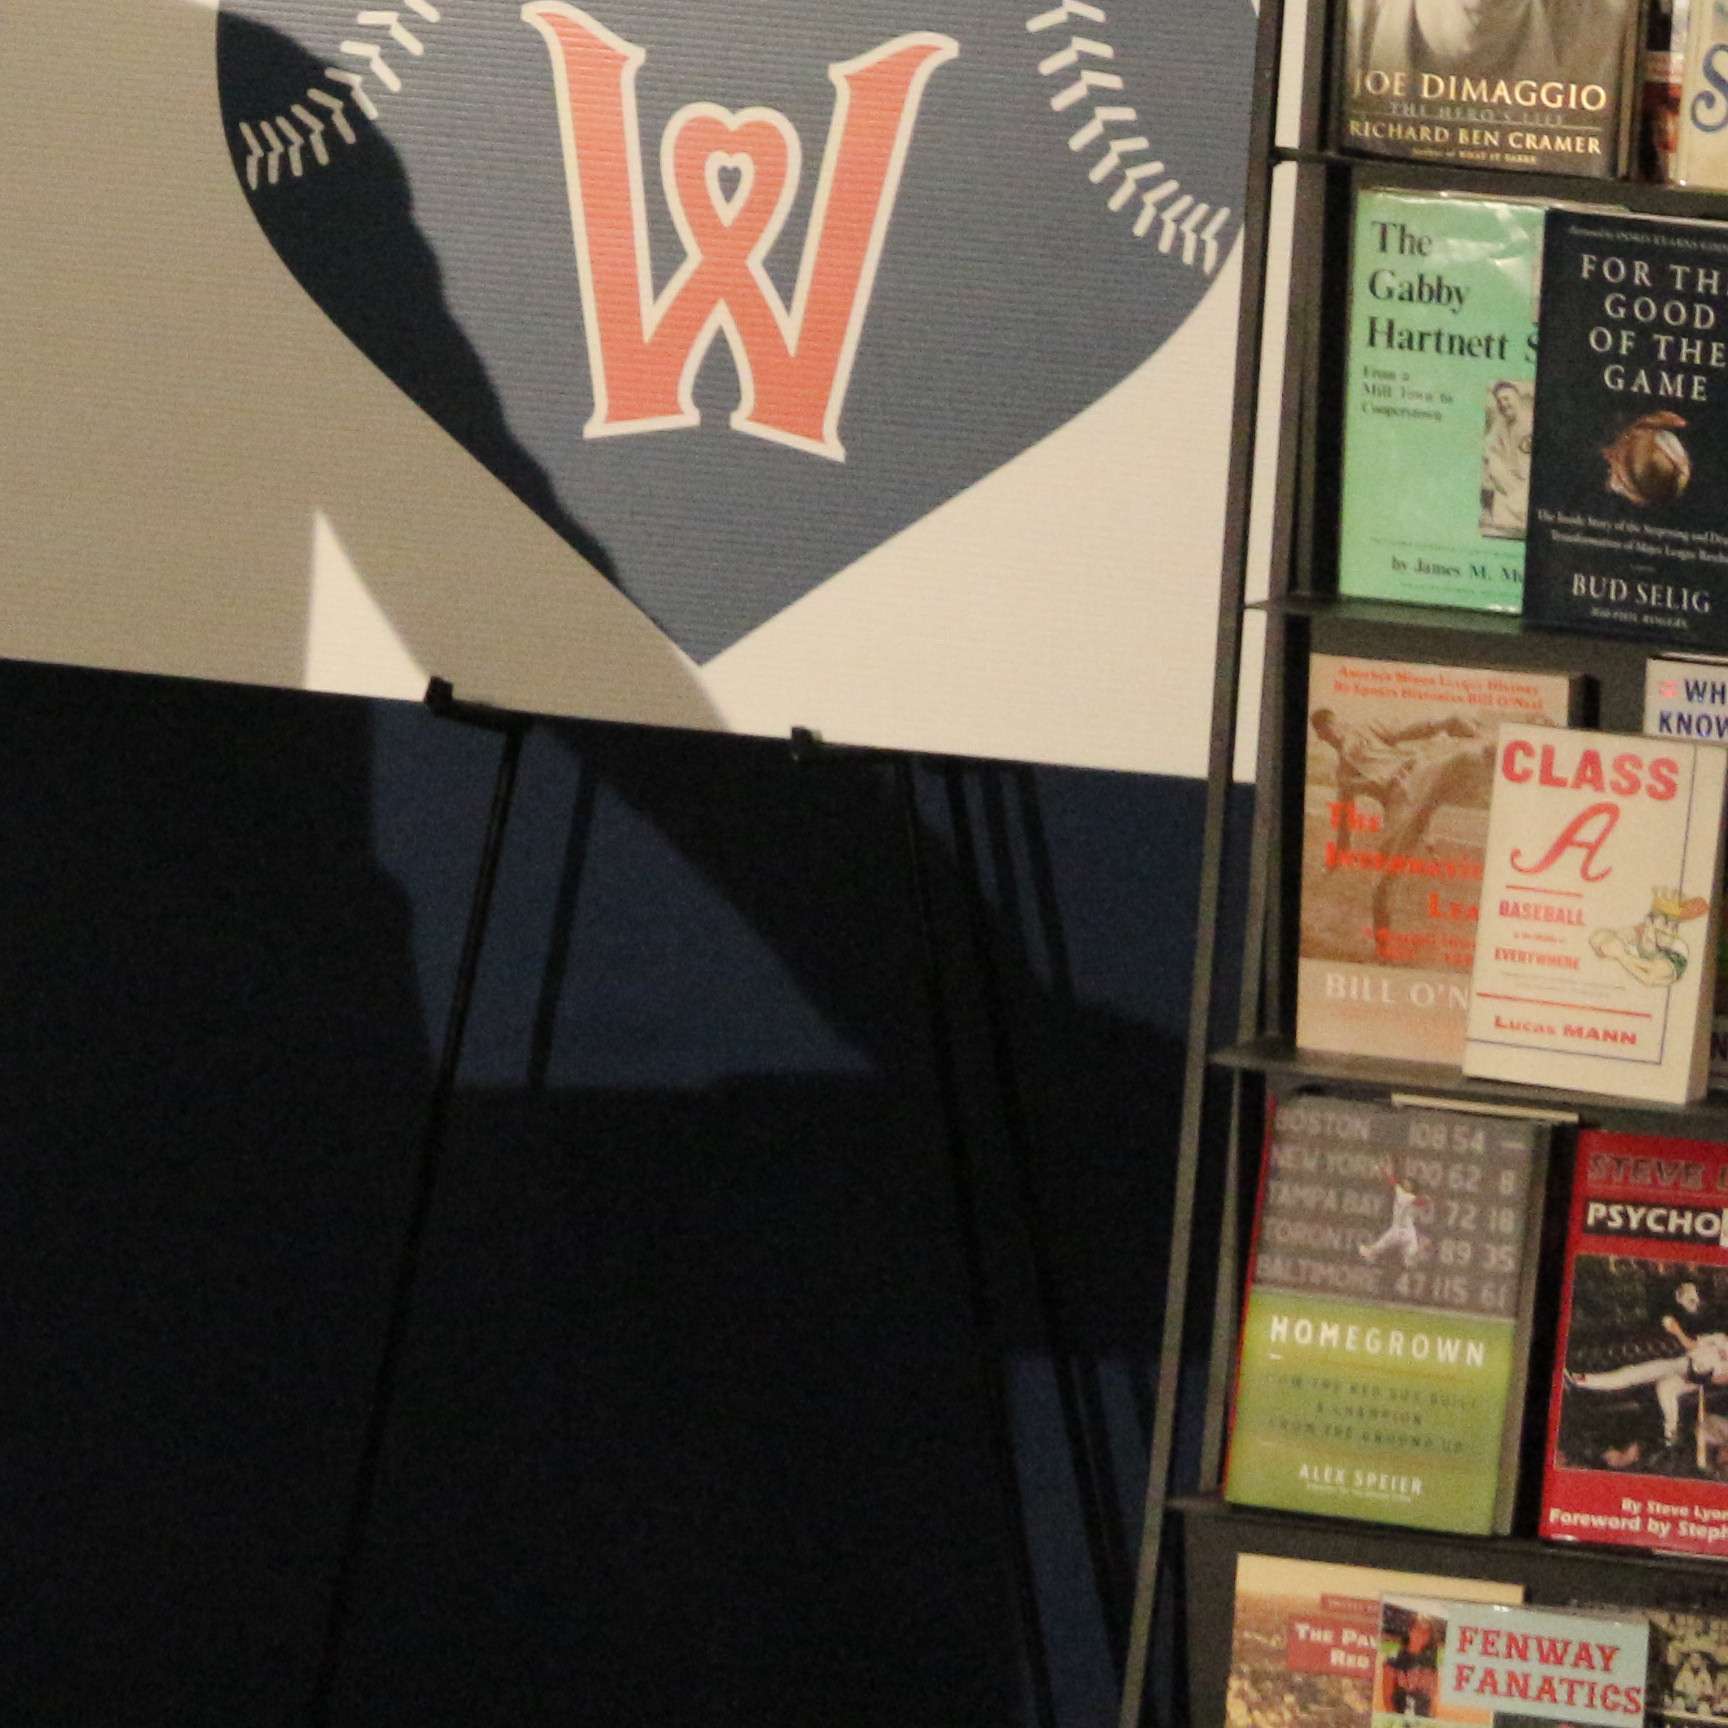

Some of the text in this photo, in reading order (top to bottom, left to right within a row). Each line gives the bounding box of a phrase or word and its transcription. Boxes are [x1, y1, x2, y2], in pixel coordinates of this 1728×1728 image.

[1353, 70, 1607, 112] JOE DIMAGGIO
[1348, 120, 1602, 155] RICHARD BEN CRAMER
[1372, 221, 1432, 257] The
[1369, 268, 1469, 314] Gabby
[1580, 253, 1728, 296] FOR TH
[1604, 292, 1716, 330] GOOD
[1369, 316, 1509, 361] Hartnett
[1588, 326, 1727, 368] OF THE
[1603, 364, 1708, 401] GAME
[1415, 557, 1461, 576] James
[1471, 564, 1492, 580] M.
[1572, 573, 1711, 613] BUD SELIG
[1501, 740, 1680, 802] CLASS
[1509, 802, 1621, 883] A
[1499, 899, 1586, 927] BASEBALL
[1495, 947, 1581, 970] EVERYWHERE
[1326, 973, 1394, 1002] BILL
[1495, 1015, 1637, 1045] Lucas MANN
[1587, 1152, 1705, 1189] STEVE
[1586, 1202, 1721, 1238] PSYCHO
[1270, 1315, 1485, 1367] HOMEGROWN
[1299, 1462, 1345, 1483] ALEX
[1354, 1470, 1423, 1496] SPEIER
[1549, 1507, 1642, 1532] Foreword
[1647, 1517, 1671, 1538] by
[1621, 1497, 1689, 1517] By Steve
[1456, 1623, 1622, 1674] FENWAY
[1452, 1663, 1643, 1717] FANATICS
